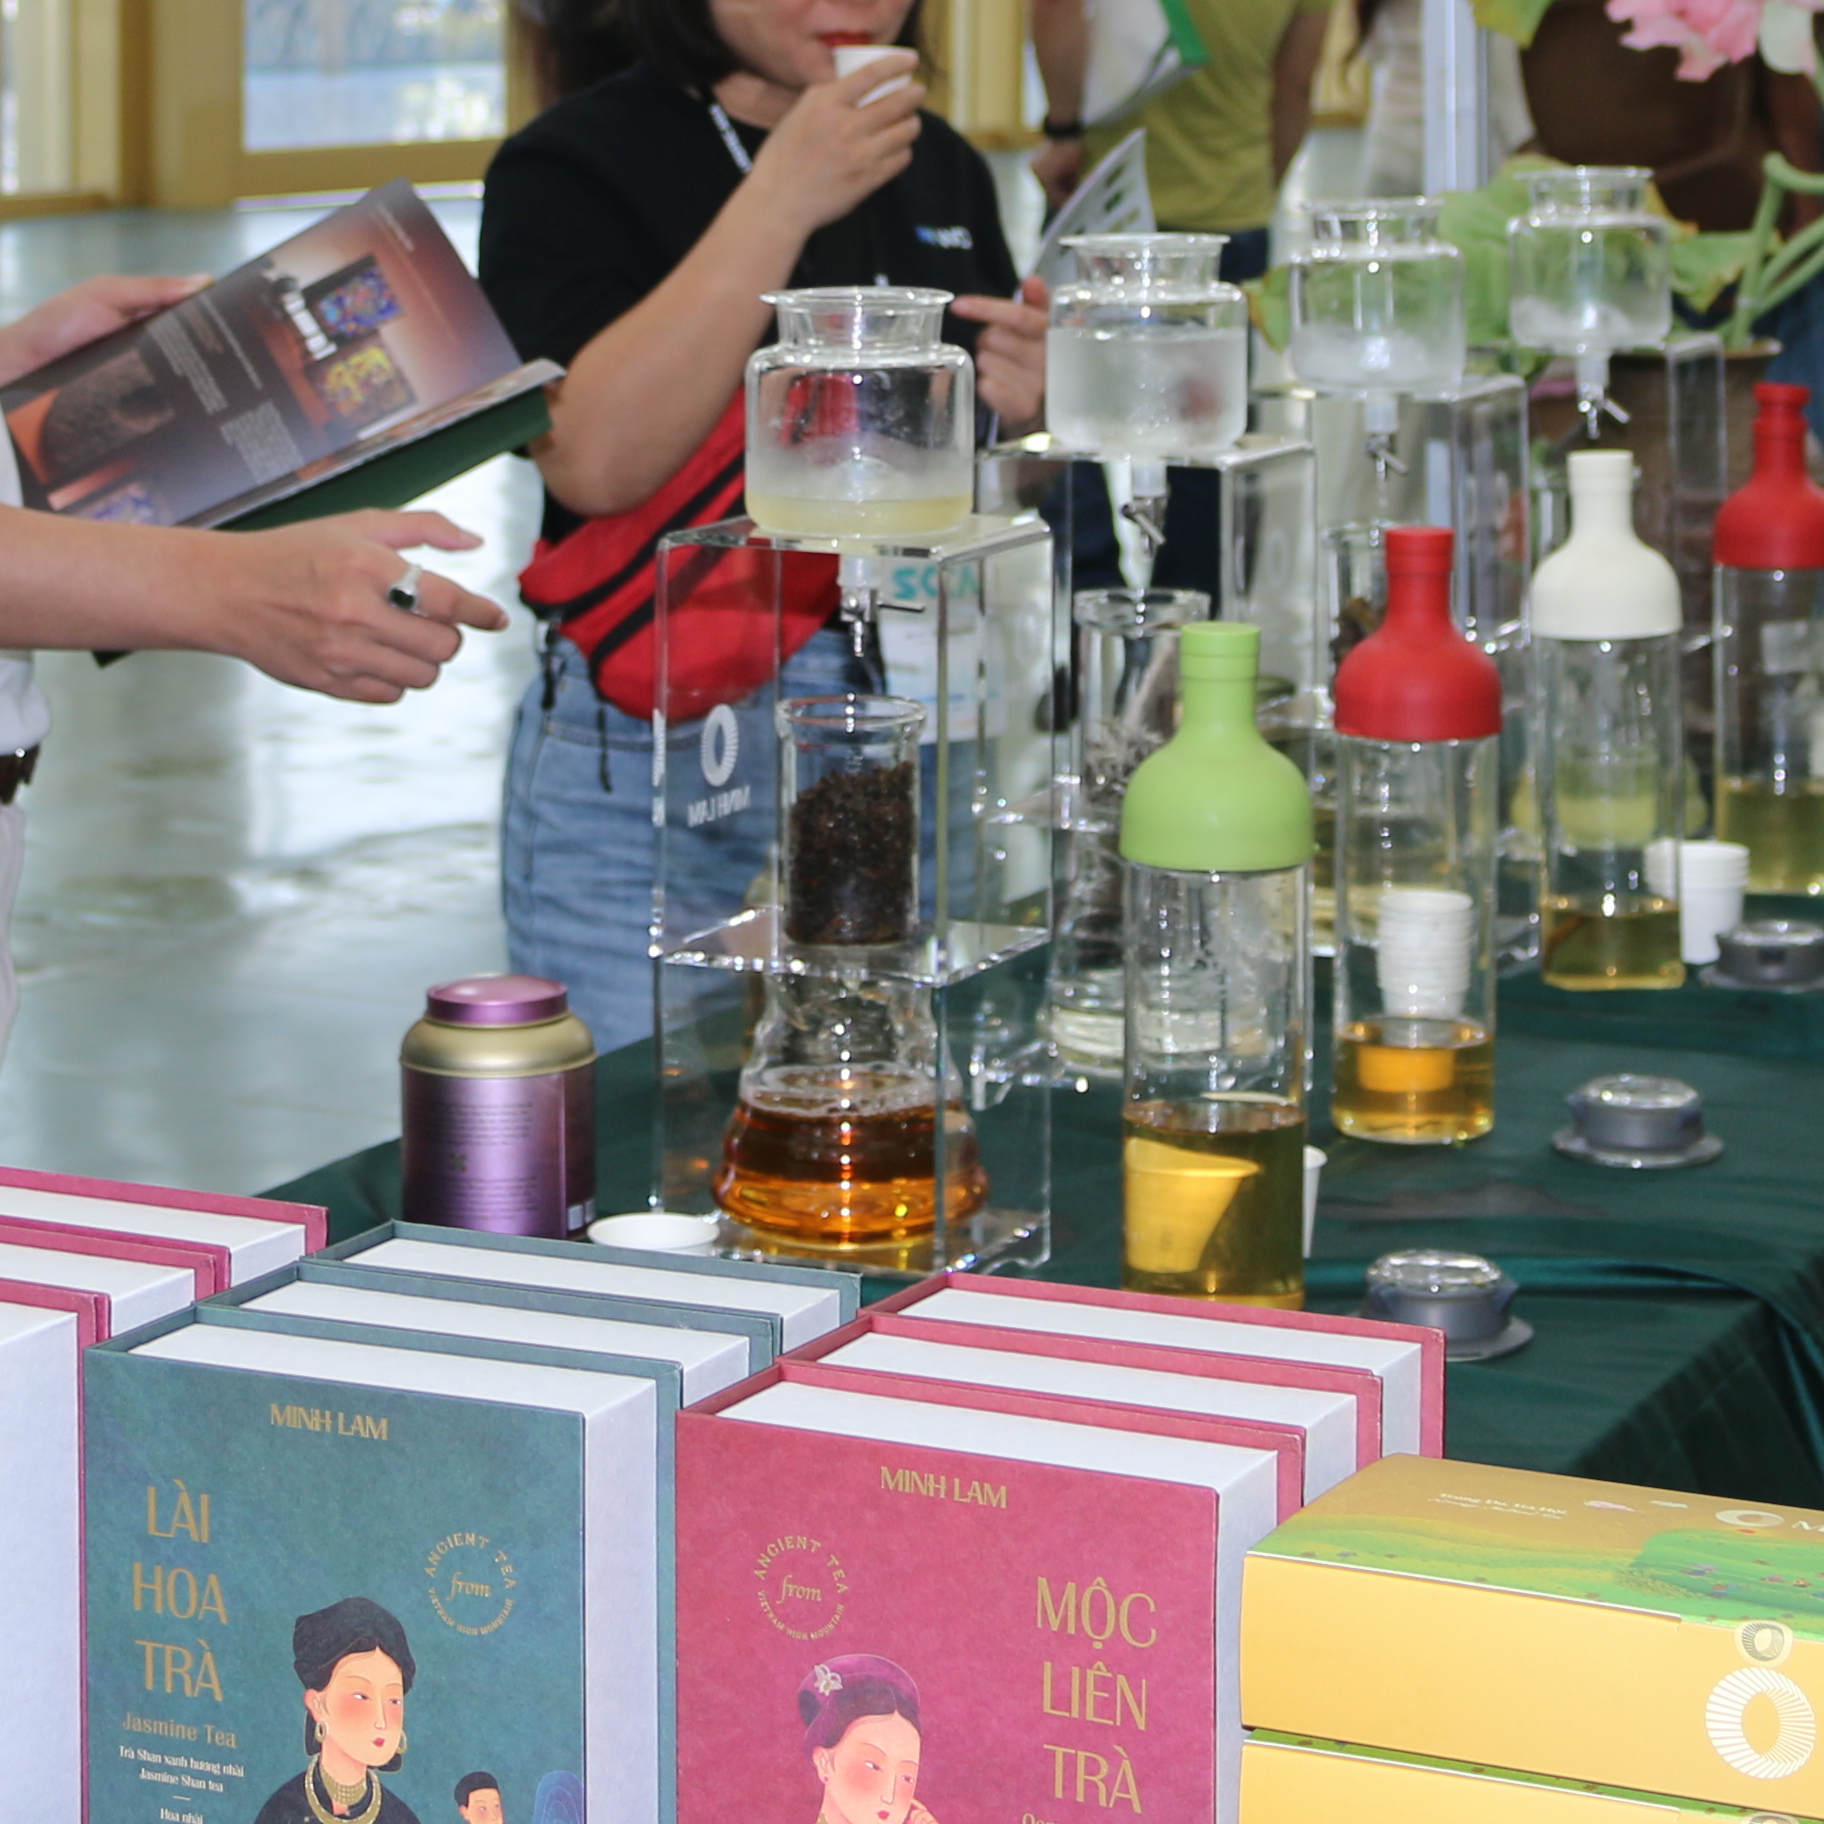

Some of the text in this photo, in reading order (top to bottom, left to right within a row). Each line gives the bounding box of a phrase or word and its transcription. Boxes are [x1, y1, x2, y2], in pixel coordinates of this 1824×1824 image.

[269, 1403, 389, 1440] MINH LAM
[147, 1478, 210, 1543] LÀI
[880, 1465, 1008, 1509] MINH LAM
[424, 1532, 518, 1589] ANCIENT TEA
[754, 1535, 849, 1594] ANCIENT TEA
[133, 1561, 228, 1624] HOA
[446, 1570, 491, 1601] from
[776, 1574, 822, 1604] from
[758, 1590, 785, 1630] VIETNAM
[811, 1603, 845, 1639] MOUNTAIN
[1036, 1576, 1157, 1650] MỘC
[135, 1639, 224, 1701] TRÀ
[1042, 1661, 1147, 1731] LIÊN
[122, 1712, 236, 1748] Jasmine Tea
[119, 1745, 135, 1759] Trà
[137, 1748, 162, 1763] Shan
[163, 1755, 188, 1768] xanh
[139, 1768, 224, 1792] Jasmine Shan tea
[1043, 1744, 1142, 1814] TRÀ
[160, 1808, 180, 1822] Hoa
